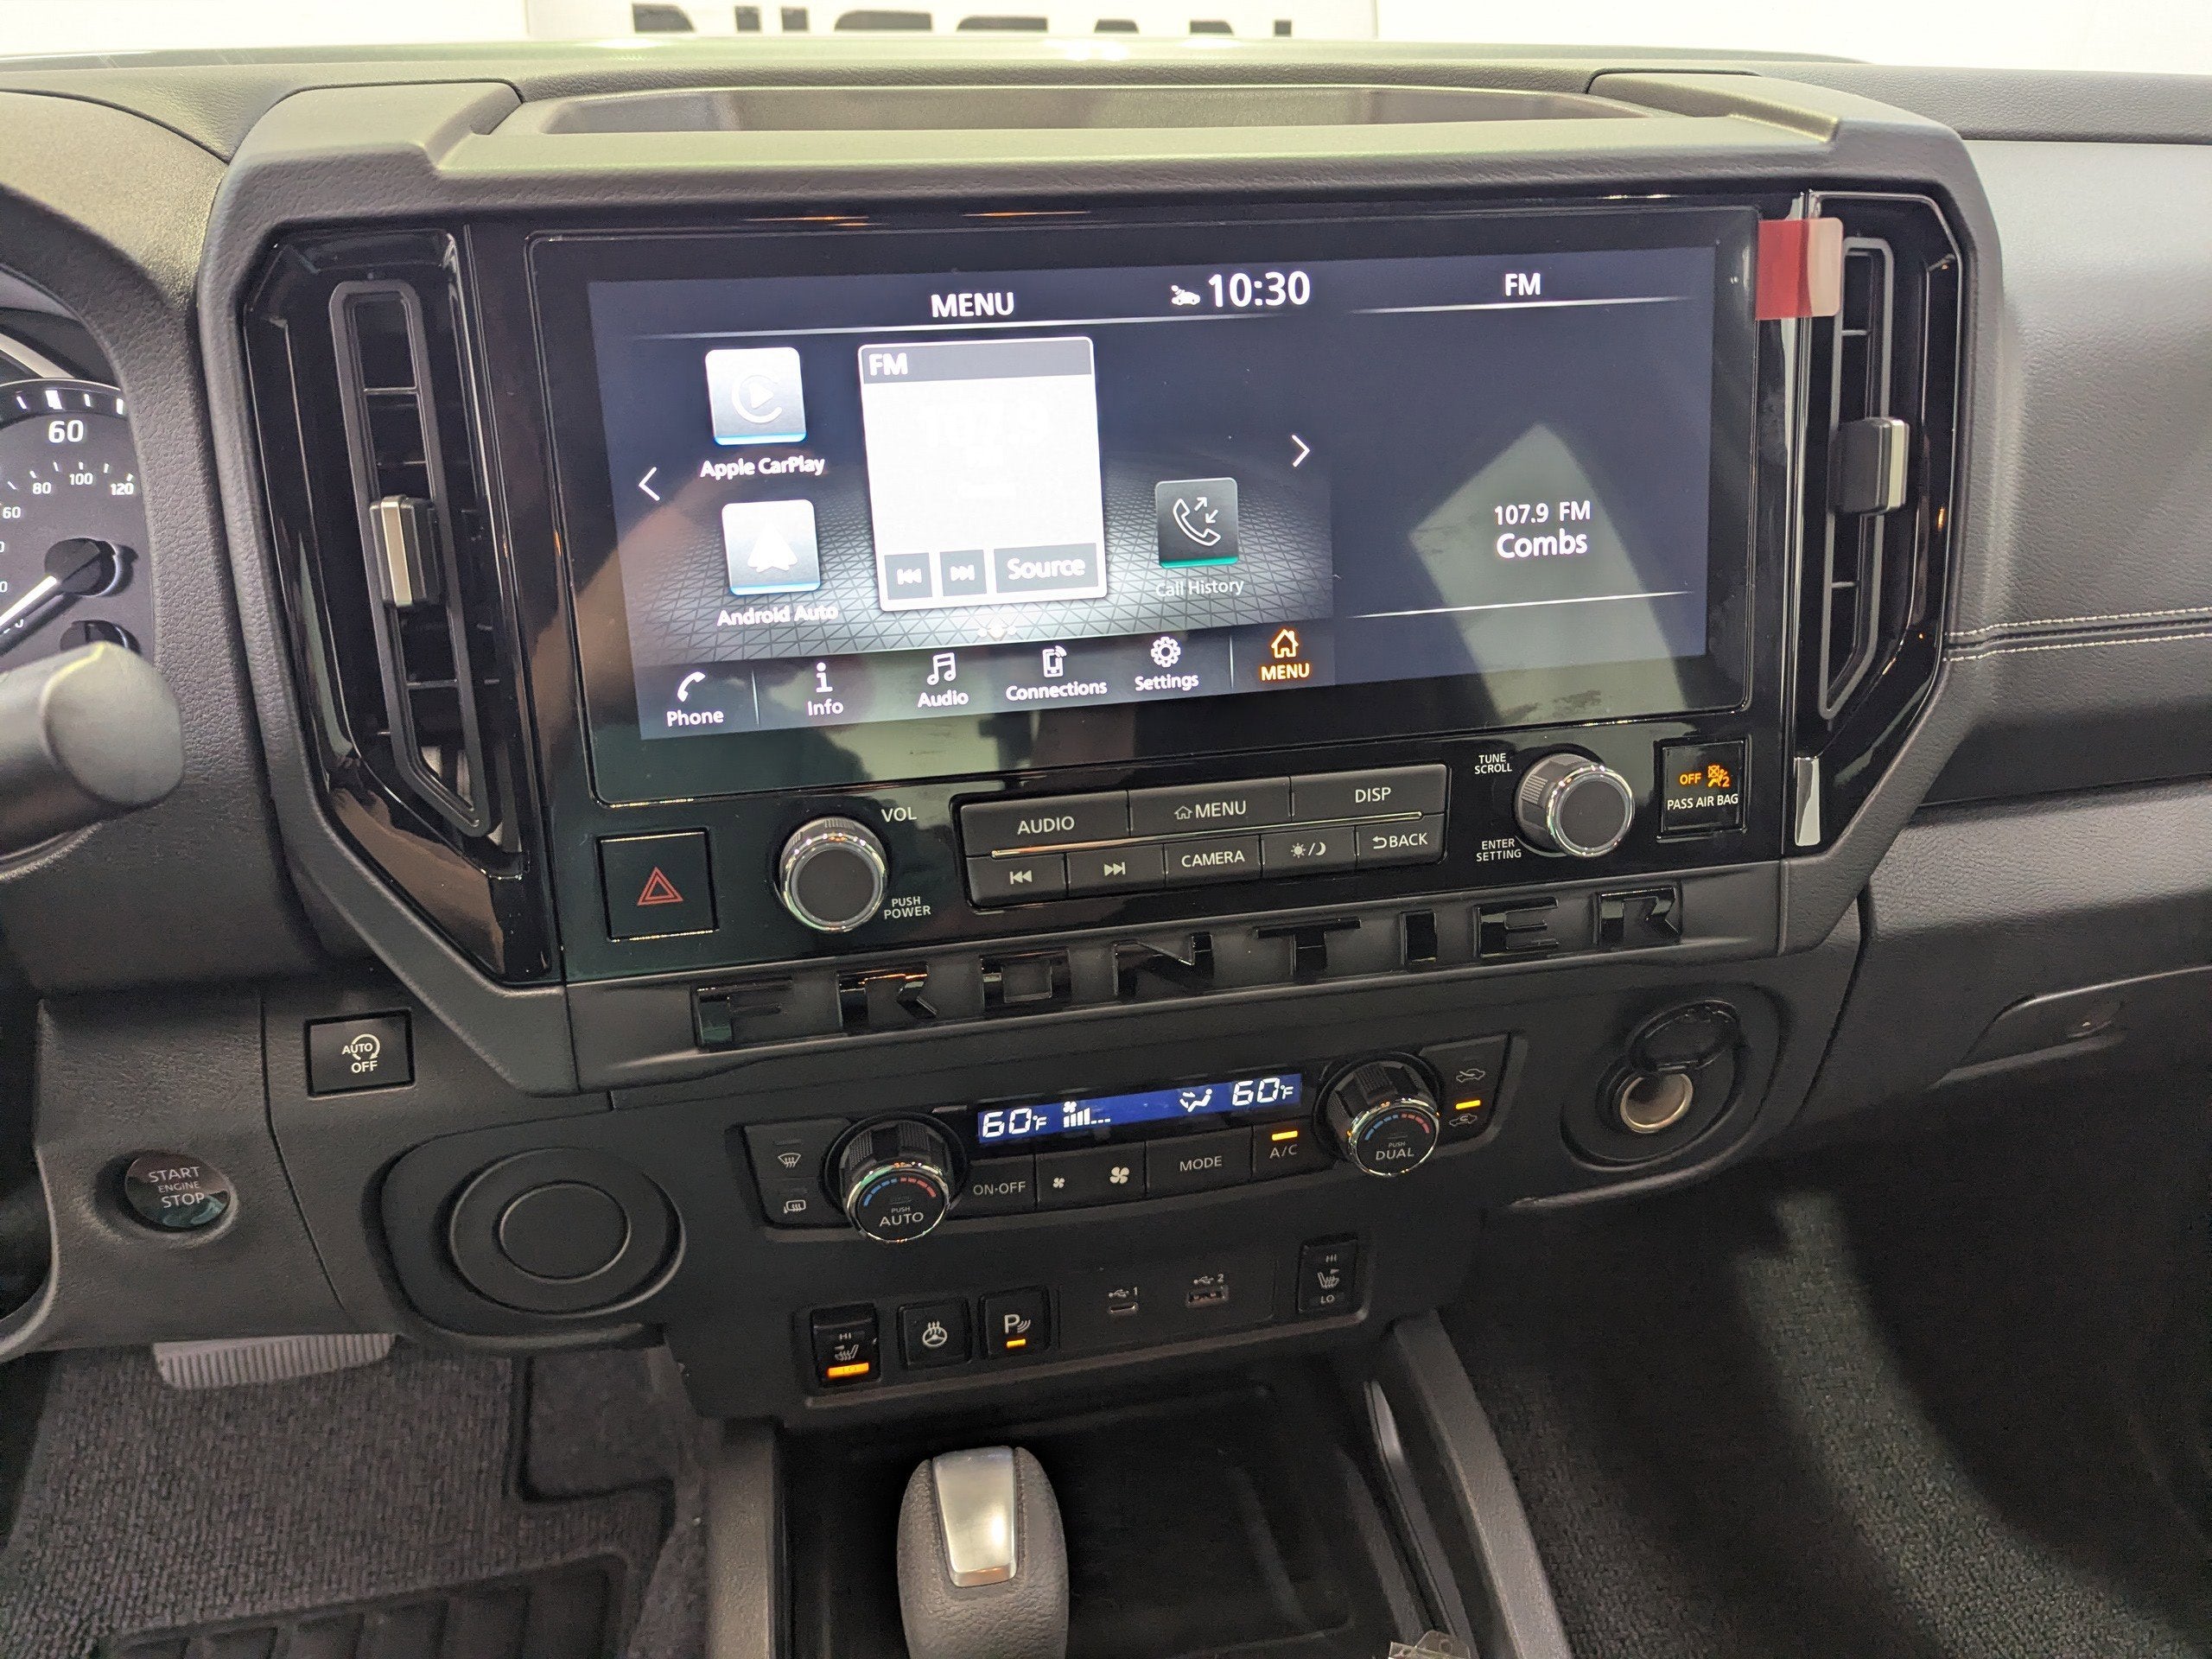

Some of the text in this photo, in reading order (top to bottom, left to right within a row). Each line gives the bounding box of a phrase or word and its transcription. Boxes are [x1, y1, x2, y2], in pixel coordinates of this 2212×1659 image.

[1209, 270, 1310, 307] 10:30
[1505, 274, 1541, 296] FM
[931, 292, 1014, 317] MENU
[869, 353, 908, 376] FM
[48, 420, 85, 442] 60
[700, 455, 825, 480] Apple CarPlay
[32, 481, 52, 494] 80
[69, 473, 92, 485] 100
[111, 483, 134, 495] 120
[3, 506, 21, 518] 60
[1494, 501, 1591, 525] 107.9 FM
[1497, 531, 1587, 558] Combs
[1007, 556, 1085, 580] Source
[1155, 577, 1244, 599] Call History
[716, 604, 838, 627] Android Auto
[1261, 663, 1310, 681] MENU
[1135, 672, 1199, 691] Settings
[918, 690, 969, 708] Audio
[1006, 681, 1107, 701] Connections
[807, 698, 843, 716] Info
[666, 710, 724, 728] Phone
[1478, 753, 1506, 764] TUNE
[1474, 763, 1513, 774] SCROLL
[1680, 772, 1701, 785] OFF
[1354, 787, 1392, 804] DISP
[1667, 793, 1738, 810] PASS AIR BAG
[880, 806, 917, 823] VOL
[1195, 800, 1247, 819] MENU
[1017, 815, 1075, 835] AUDIO
[1389, 832, 1427, 849] BACK
[1481, 838, 1515, 850] ENTER
[1181, 849, 1245, 868] CAMERA
[1476, 849, 1522, 862] SETTING
[892, 896, 921, 907] PUSH
[884, 905, 931, 919] POWER
[694, 880, 1683, 1051] FRONTIER
[342, 1042, 373, 1056] AUTO
[351, 1060, 378, 1074] OFF
[1269, 1145, 1298, 1160] A/C
[1375, 1147, 1414, 1161] DUAL
[1179, 1155, 1222, 1173] MODE
[149, 1166, 200, 1184] START
[158, 1181, 200, 1193] ENGINE
[162, 1192, 205, 1209] STOP
[879, 1211, 925, 1228] AUTO
